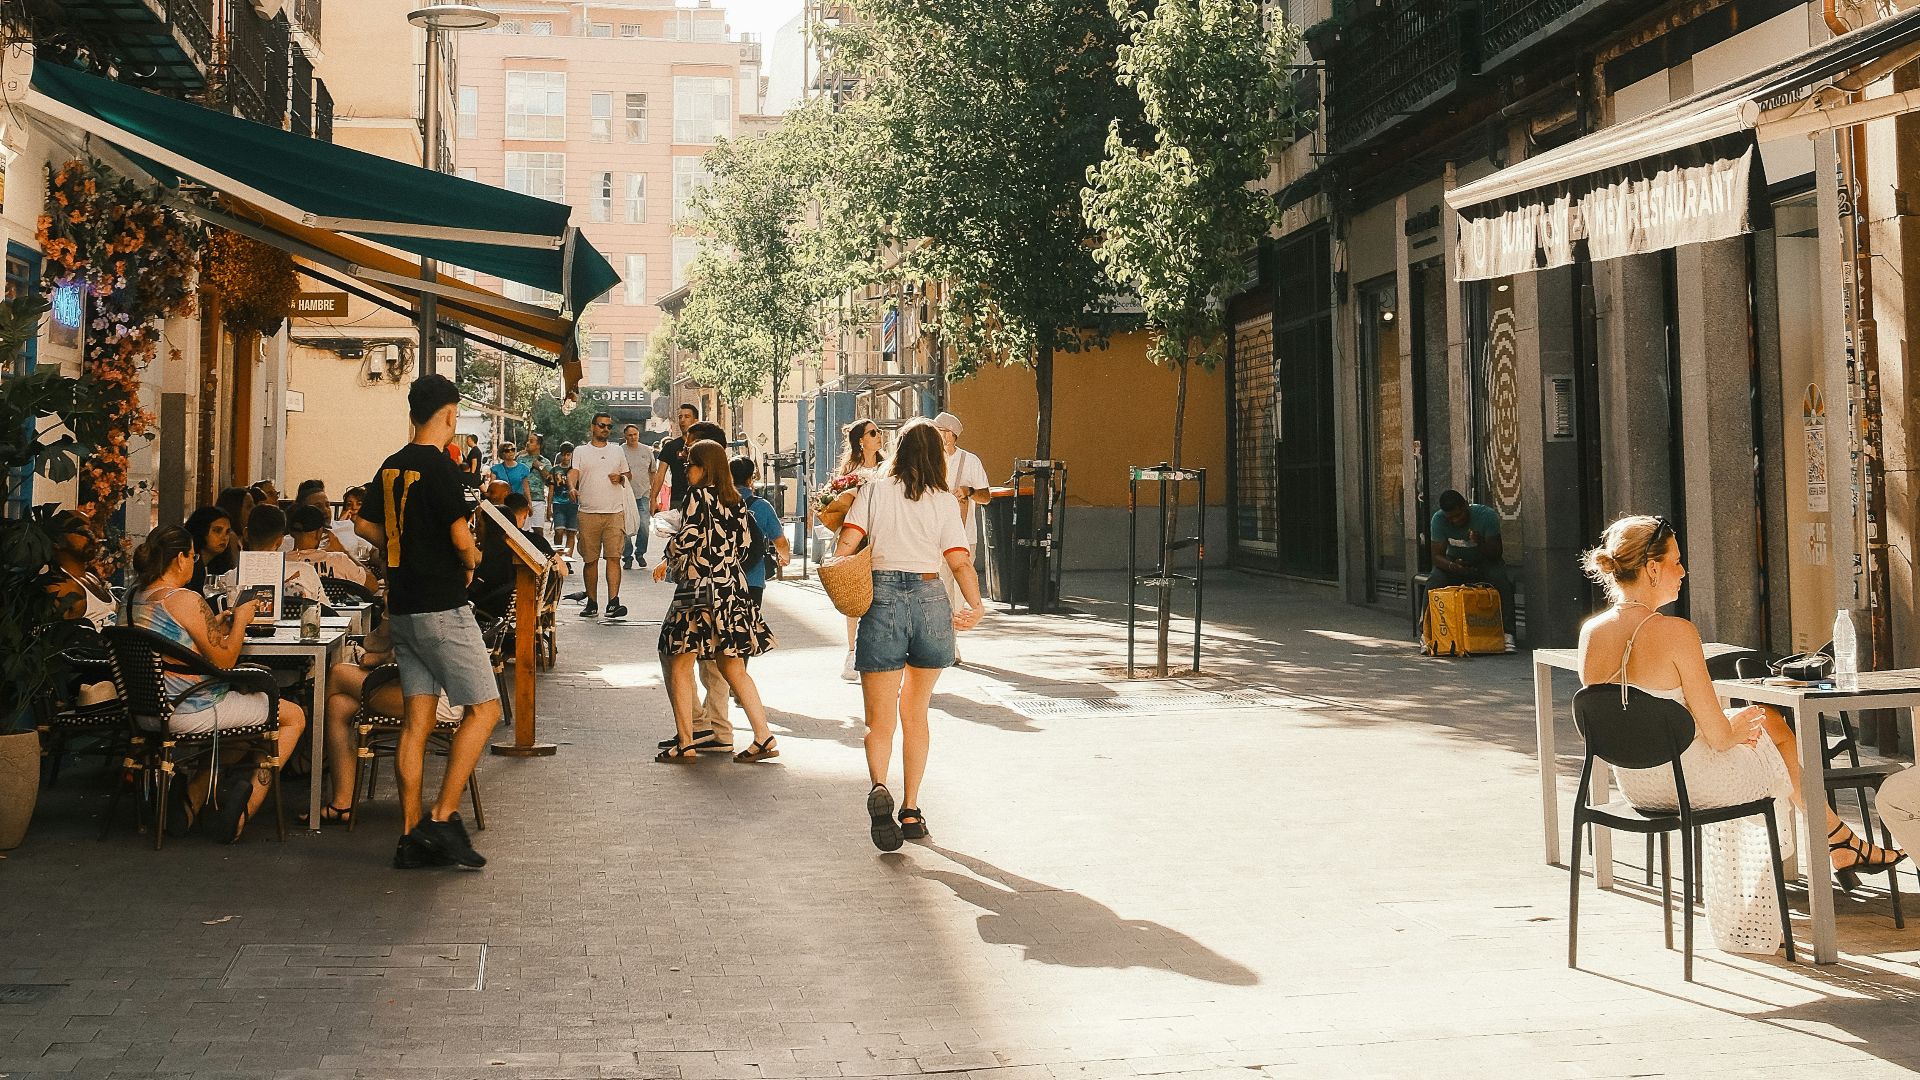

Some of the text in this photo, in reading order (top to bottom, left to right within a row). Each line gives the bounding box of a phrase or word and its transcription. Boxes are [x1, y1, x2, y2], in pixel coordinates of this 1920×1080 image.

[1627, 170, 1733, 229] RESTAURANT
[298, 299, 335, 311] HAMBRE
[592, 390, 645, 401] COFFEE
